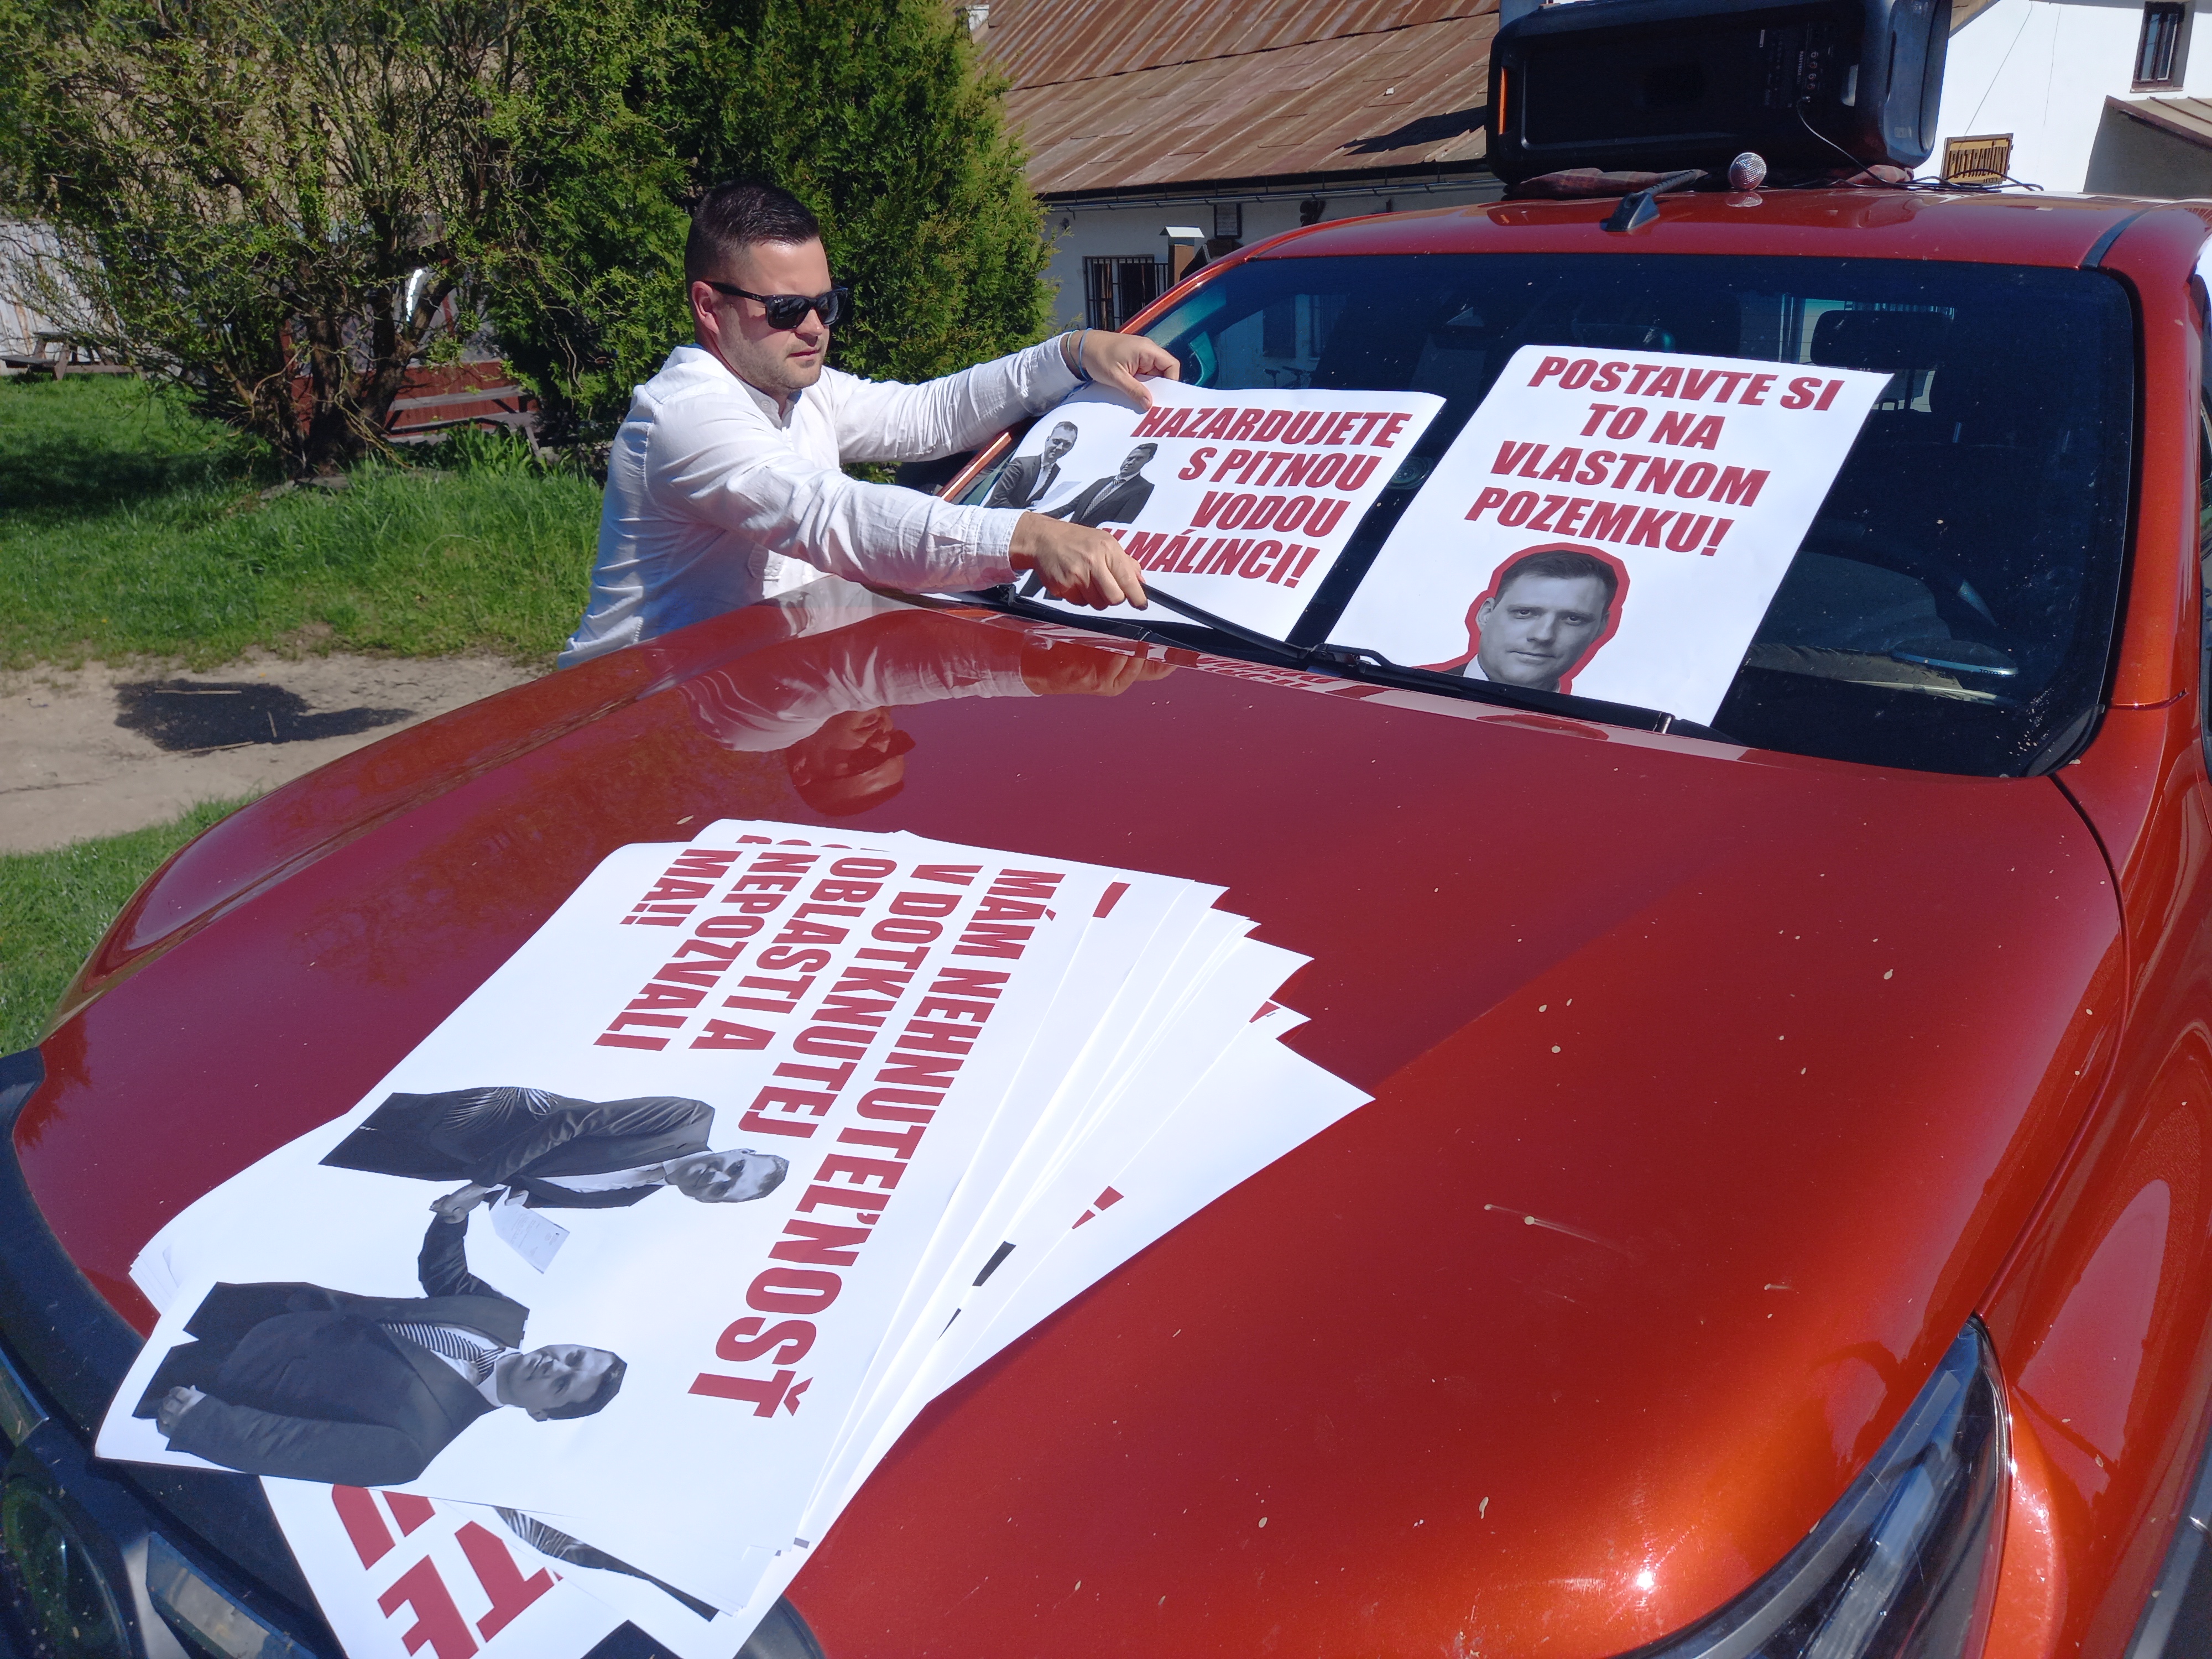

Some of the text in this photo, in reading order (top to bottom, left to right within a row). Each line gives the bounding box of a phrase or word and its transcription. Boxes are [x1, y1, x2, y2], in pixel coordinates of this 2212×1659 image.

[1527, 356, 1844, 411] POSTAVTE SI
[1130, 406, 1412, 448] HAZARDUJETE
[1580, 403, 1725, 450] TO NA
[1178, 447, 1382, 491] S PITNOU
[1490, 440, 1771, 507] VLASTNOM
[1190, 491, 1350, 538] VODOU
[1464, 487, 1735, 557] POZEMKU!
[620, 849, 743, 927] MA!!
[910, 864, 984, 886] V
[721, 857, 898, 1014] OBLASTI
[951, 868, 1066, 960] MÁM
[593, 852, 821, 1051] NEPOZVALI
[688, 1019, 776, 1050] A
[738, 891, 963, 1139] DOTKNUTEJ
[687, 967, 1011, 1418] NEHNUTEĽNOSŤ
